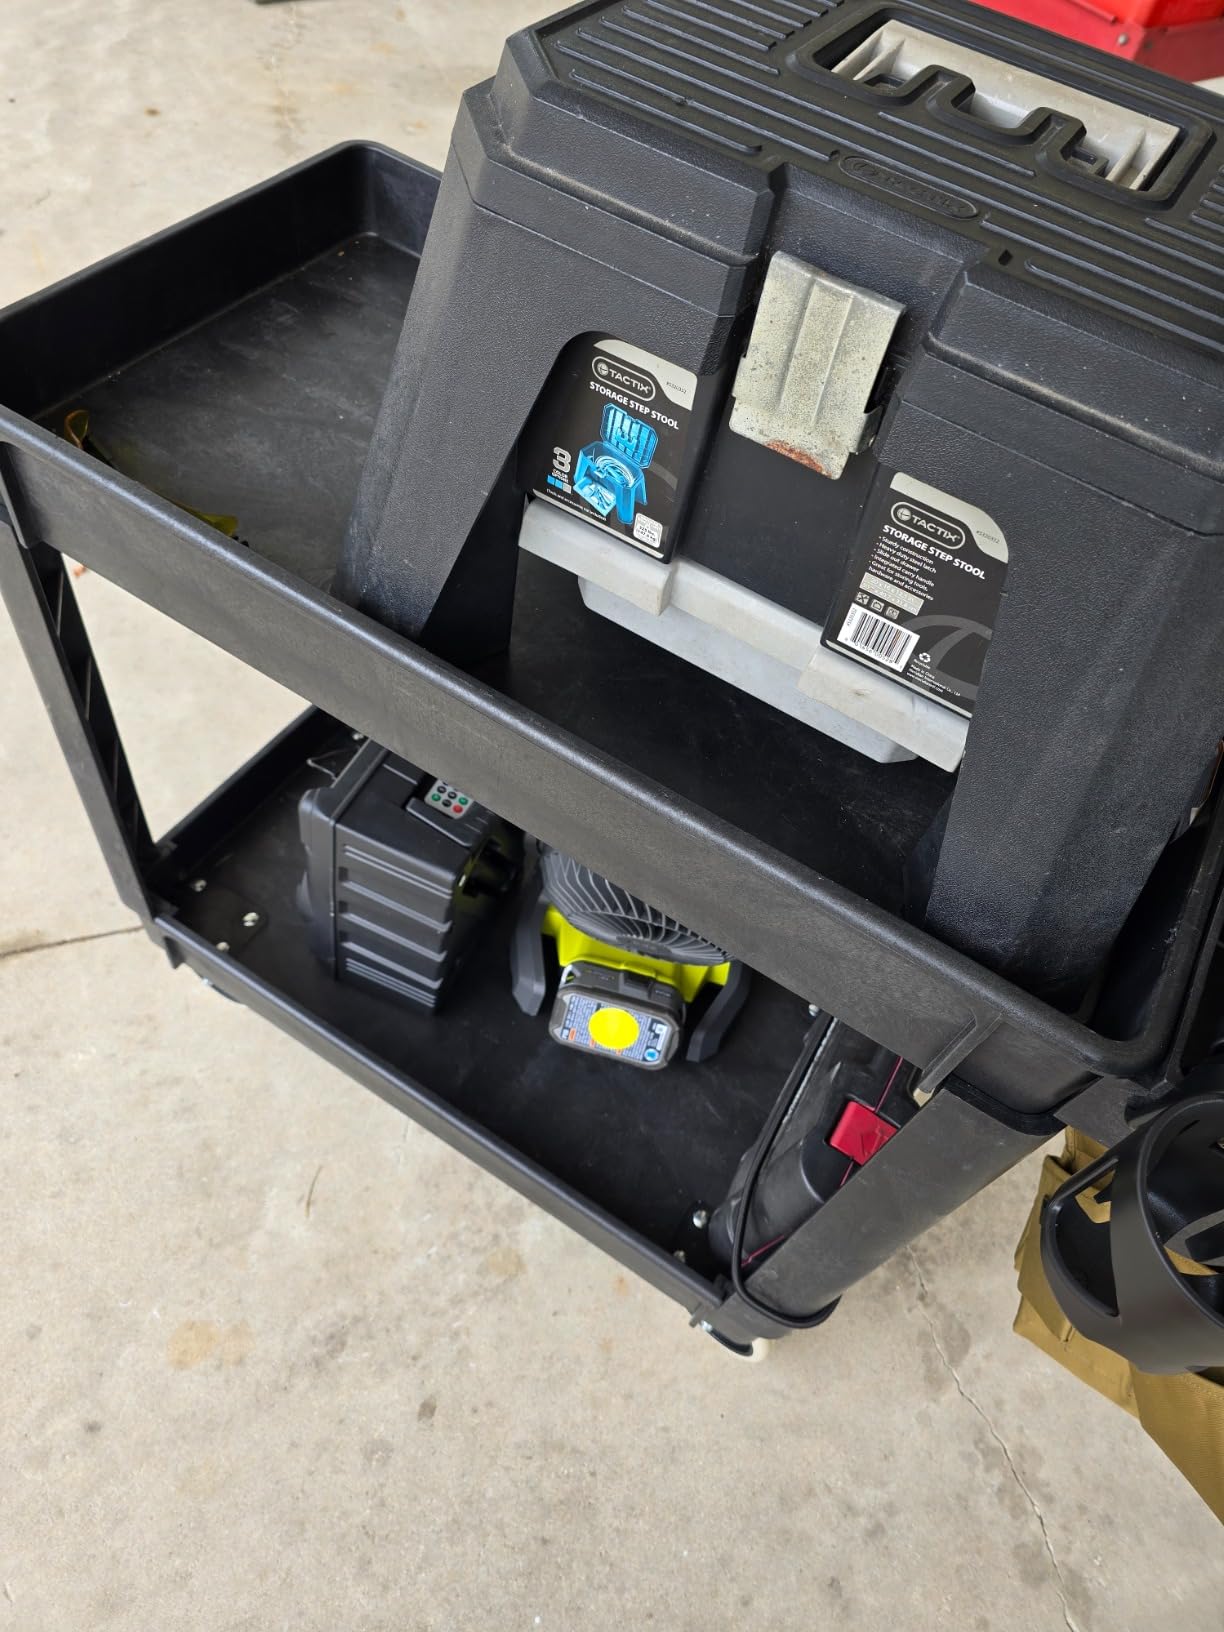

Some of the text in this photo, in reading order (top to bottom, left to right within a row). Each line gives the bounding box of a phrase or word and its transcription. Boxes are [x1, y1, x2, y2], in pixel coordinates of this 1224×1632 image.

[609, 368, 649, 394] TACTIX
[589, 381, 679, 430] STORAGE STEP STOOL
[552, 446, 572, 473] 3
[912, 514, 957, 543] TACTIX
[876, 548, 890, 558] Slide
[900, 560, 920, 573] drawer
[879, 543, 937, 574] Heavy duty steel latch
[881, 536, 934, 565] Sturdy construction
[882, 524, 986, 580] STORAGE STEP STOOL
[868, 566, 934, 601] hardware and accessories
[871, 560, 886, 571] Great
[894, 572, 914, 585] storing
[874, 554, 935, 587] Integrated carry handle
